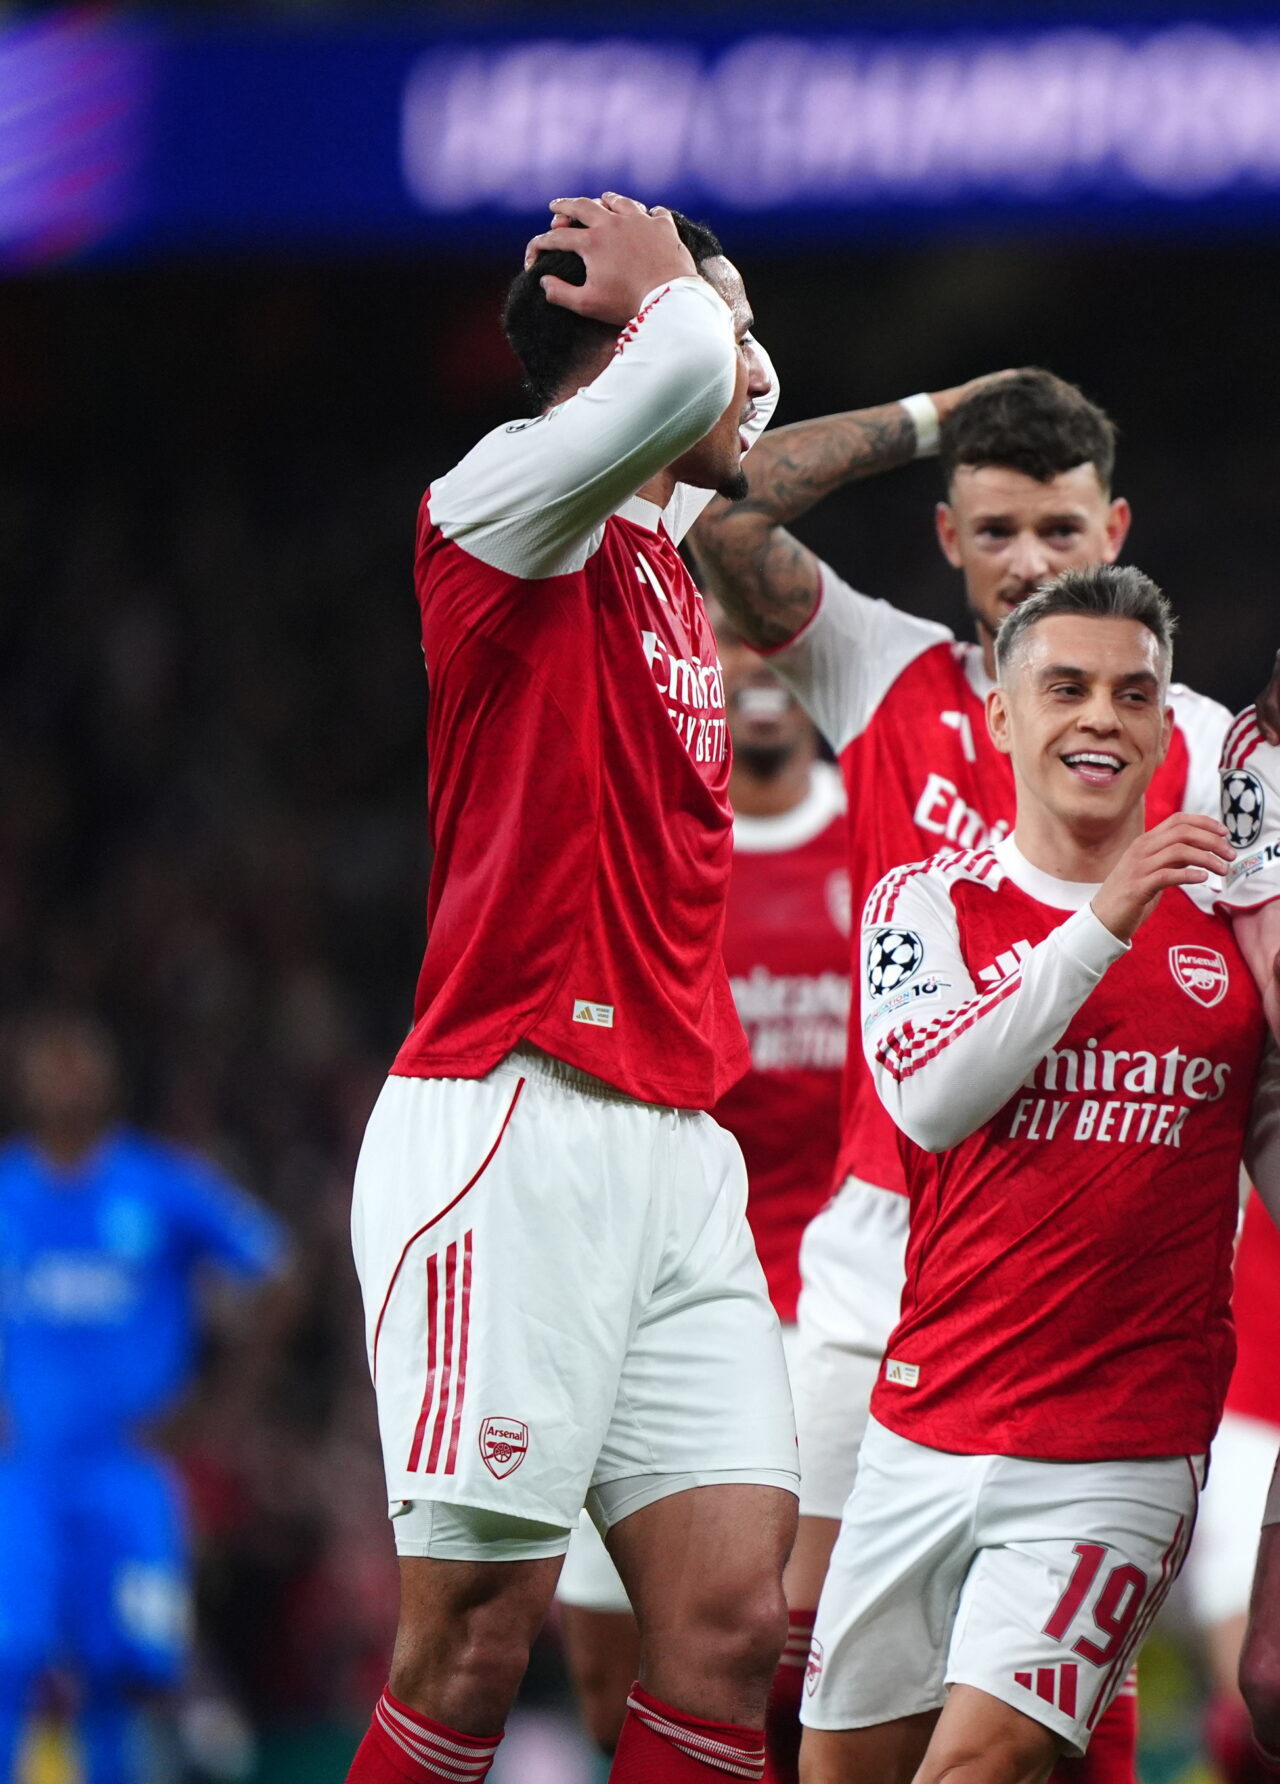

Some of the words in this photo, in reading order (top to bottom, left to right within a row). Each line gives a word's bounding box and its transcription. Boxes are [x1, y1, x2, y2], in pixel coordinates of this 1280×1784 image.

[1024, 1037, 1231, 1102] mirates
[1008, 1098, 1070, 1141] FLY
[1073, 1099, 1191, 1149] BETTER
[486, 1426, 523, 1441] Arsenal
[1040, 1542, 1148, 1669] 19
